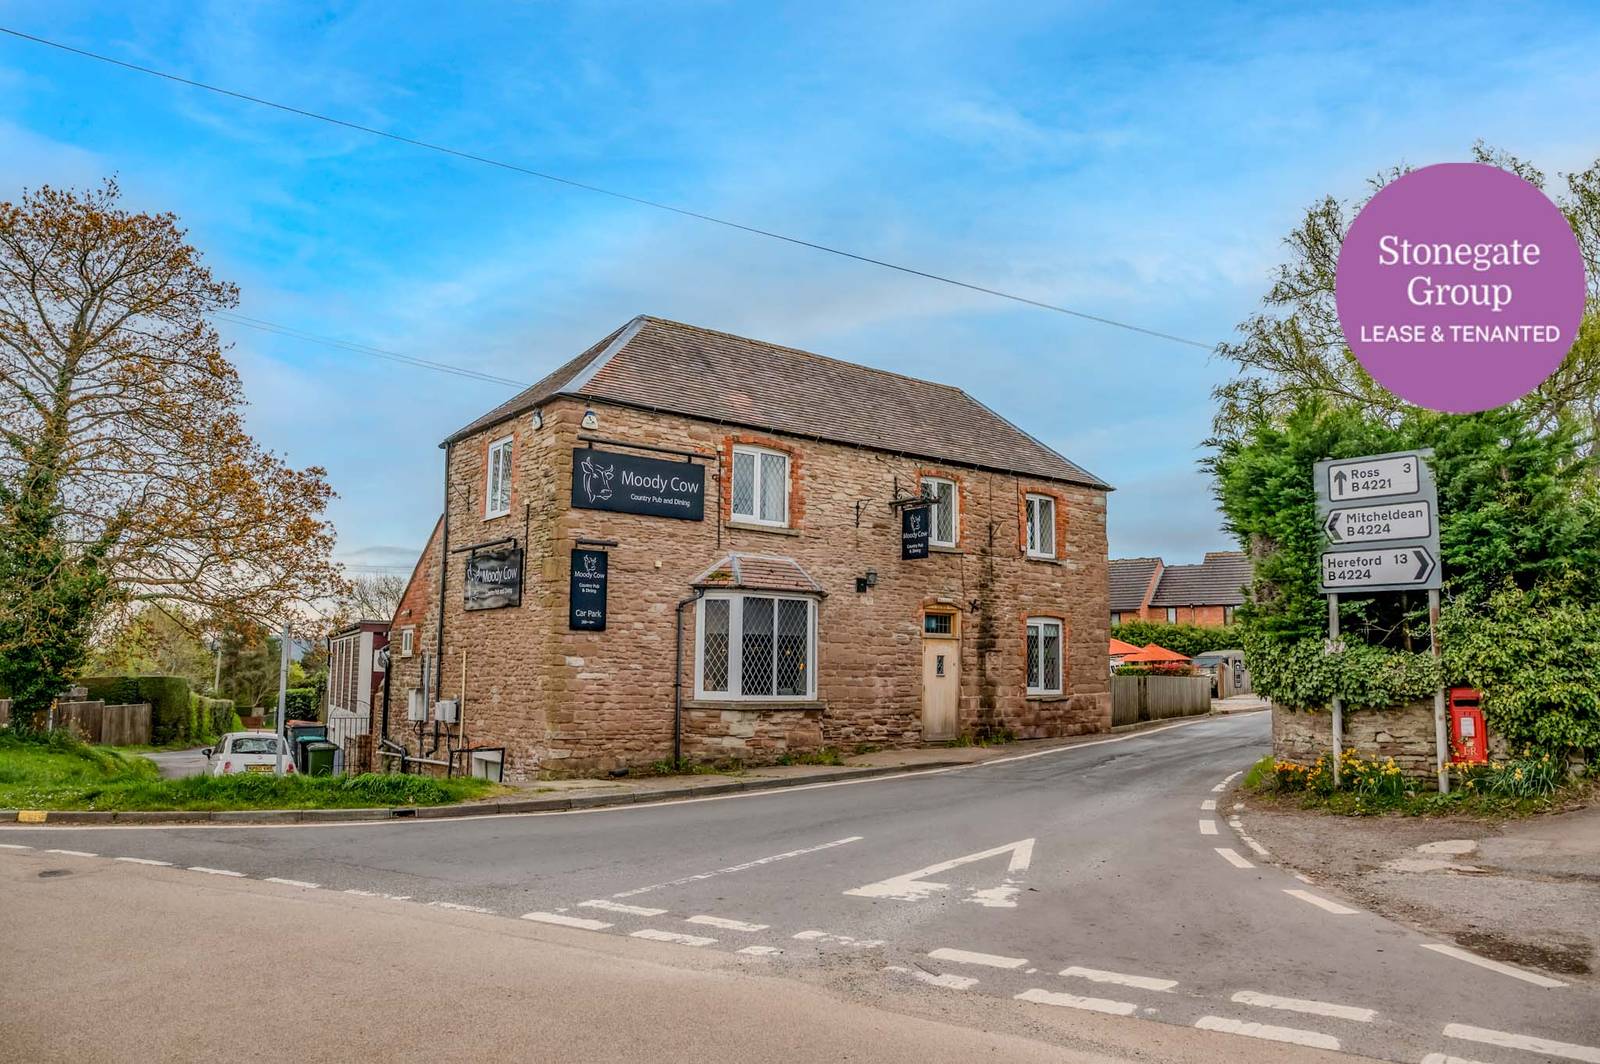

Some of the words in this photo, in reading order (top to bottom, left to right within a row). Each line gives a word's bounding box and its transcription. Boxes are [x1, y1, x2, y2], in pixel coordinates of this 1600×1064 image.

[1351, 469, 1380, 479] Ross
[1403, 463, 1411, 473] 3
[621, 470, 668, 493] Moody
[670, 476, 699, 493] Cow
[630, 493, 652, 503] Country
[652, 496, 662, 504] Pub
[674, 498, 691, 508] Dining
[1346, 509, 1423, 523] Mitcheldean
[1327, 556, 1382, 568] Hereford
[1394, 553, 1408, 564] 13
[482, 567, 503, 584] Moody
[503, 566, 518, 580] Cow
[574, 570, 593, 579] Moody
[593, 571, 605, 579] Cow
[575, 609, 587, 617] Car
[587, 610, 602, 618] Park
